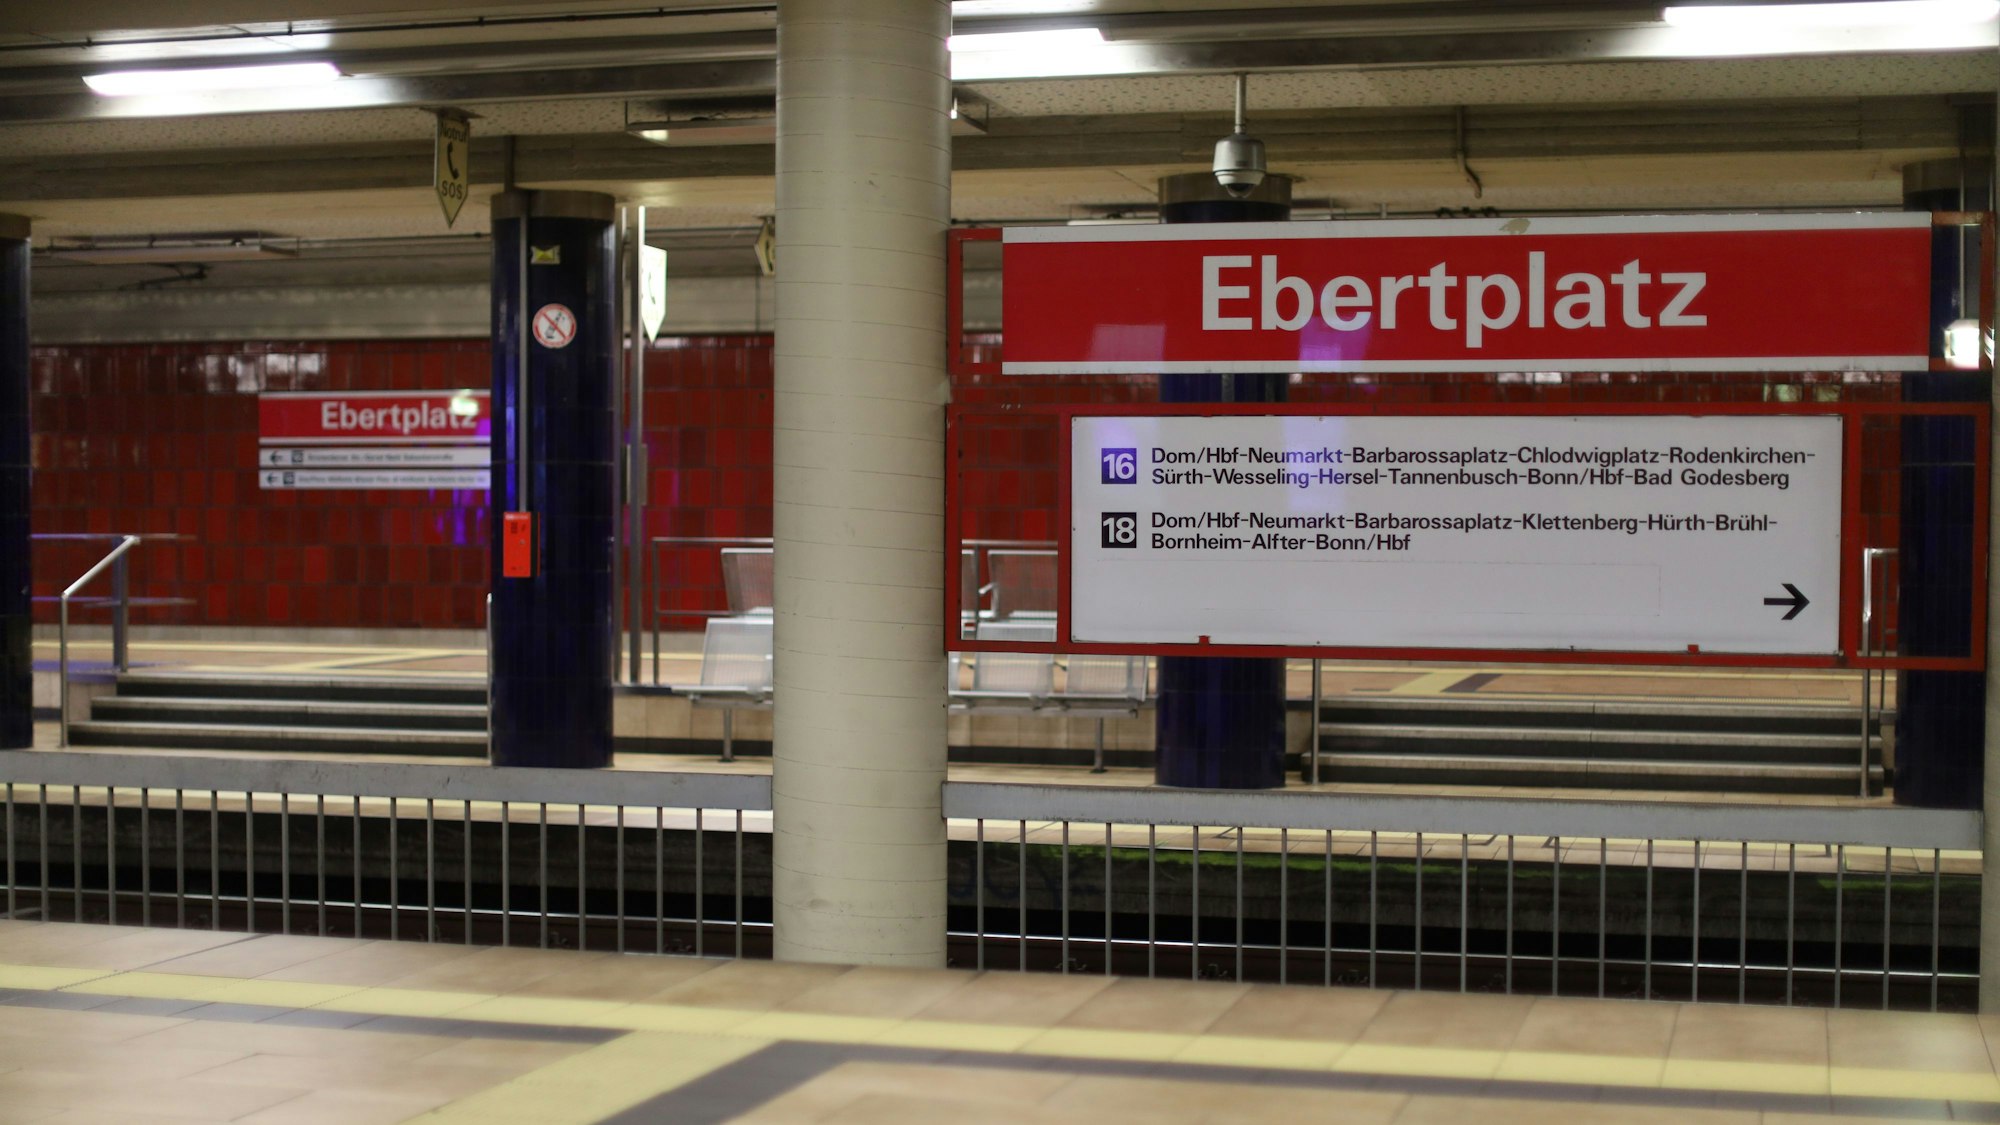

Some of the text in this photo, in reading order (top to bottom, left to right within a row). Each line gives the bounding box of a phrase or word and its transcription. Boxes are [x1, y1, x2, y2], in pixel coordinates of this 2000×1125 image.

[442, 181, 462, 200] SOS
[1203, 251, 1708, 348] Ebertplatz
[321, 400, 477, 435] Ebertplatz
[1103, 453, 1135, 480] 16
[1151, 446, 1816, 468] Dom/Hbf-Neumarkt-Barbarossaplatz-Chlodwigplatz-Rodenkirchen-
[1151, 468, 1790, 491] Sürth-Wesseling-Hersel-Tannenbusch-Bonn/Hbf-Bad Godesberg
[1103, 517, 1135, 544] 18
[1151, 511, 1778, 535] Dom/Hbf-Neumarkt-Barbarossaplatz-Klettenberg-Hürth-Brühl-
[1151, 532, 1411, 551] Bornheim-Alfter-Bonn/Hbf
